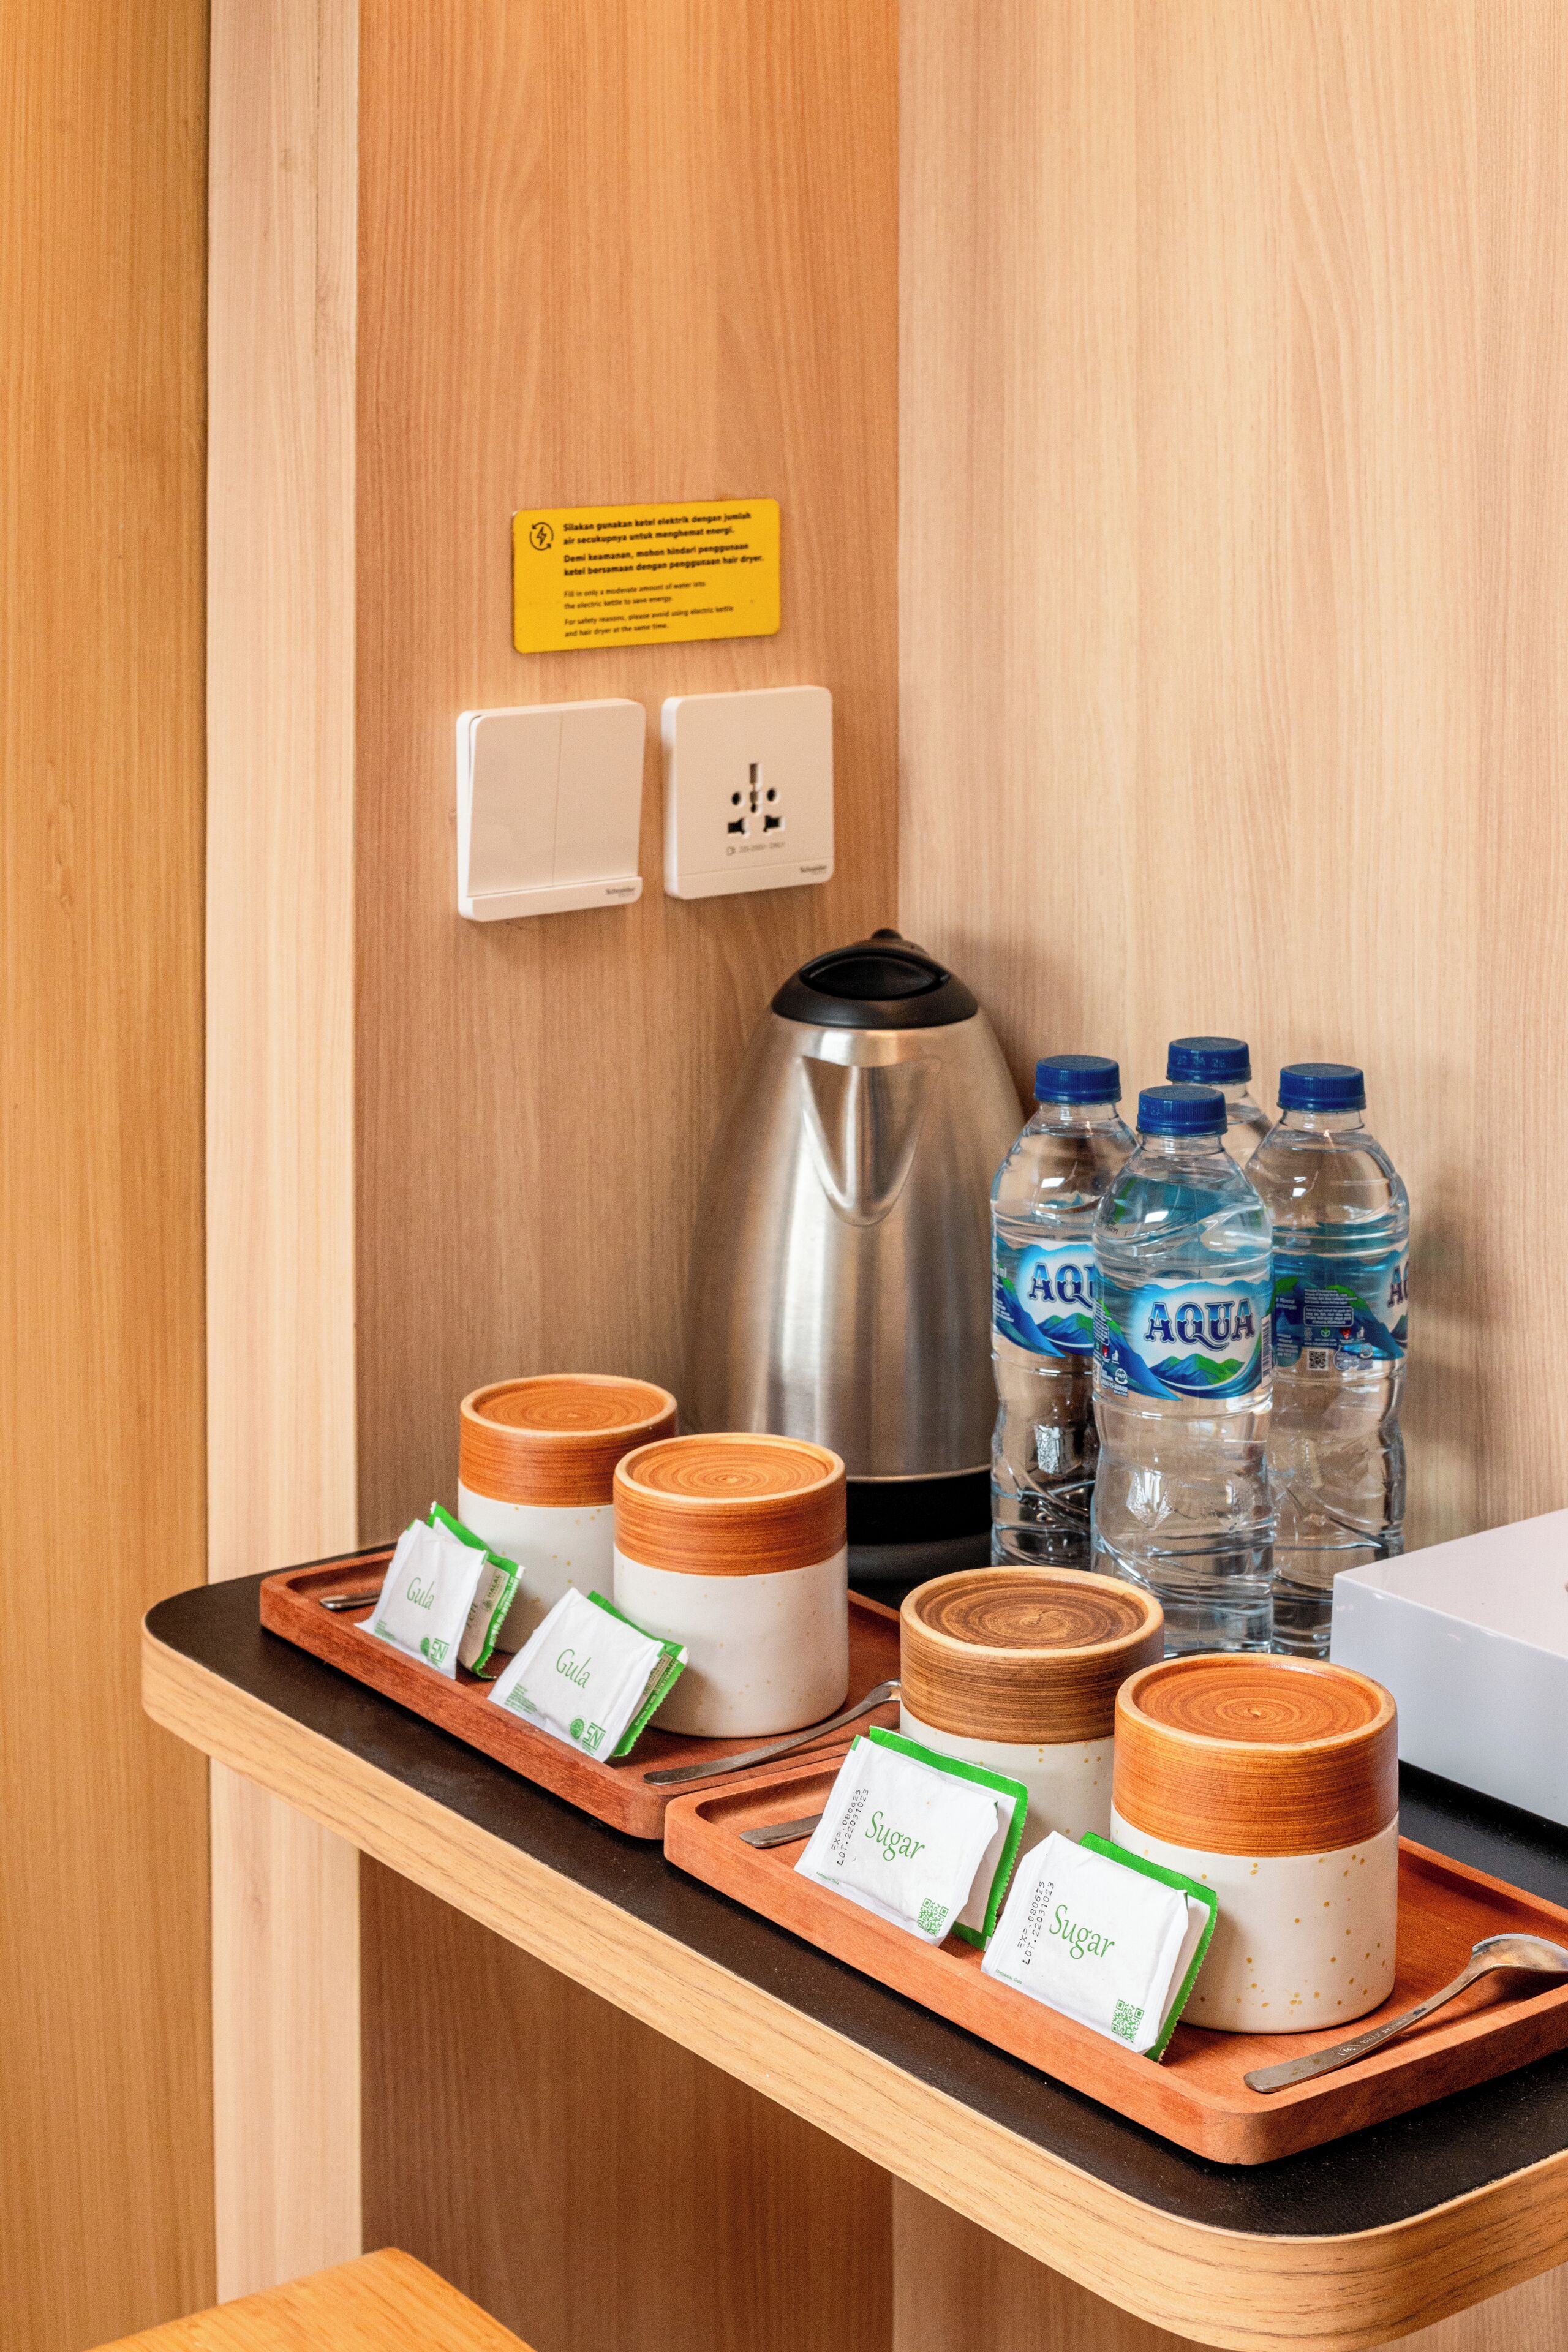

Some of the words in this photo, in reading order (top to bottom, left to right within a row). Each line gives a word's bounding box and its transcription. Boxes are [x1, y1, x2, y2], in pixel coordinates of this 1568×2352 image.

[577, 535, 627, 544] secukupnya
[630, 532, 652, 540] untuk
[655, 529, 704, 538] menghemat
[706, 526, 734, 535] energi.
[597, 521, 632, 530] gunakan
[658, 516, 688, 525] elektrik
[724, 511, 751, 522] jumlah
[564, 554, 586, 562] Demi
[588, 552, 634, 561] keamanan,
[666, 546, 696, 555] hindari
[698, 543, 748, 554] penggunaan
[564, 567, 586, 576] ketel
[588, 565, 633, 574] bersamaan
[636, 562, 667, 571] dengan
[669, 559, 720, 570] penggunaan
[741, 554, 764, 564] dryer.
[1028, 1262, 1093, 1311] AQ
[1144, 1298, 1256, 1352] AQUA
[406, 1577, 435, 1611] Gula
[556, 1648, 592, 1689] Gula
[582, 1722, 606, 1751] SNI
[864, 1811, 925, 1861] Sugar
[1049, 1904, 1115, 1960] Sugar
